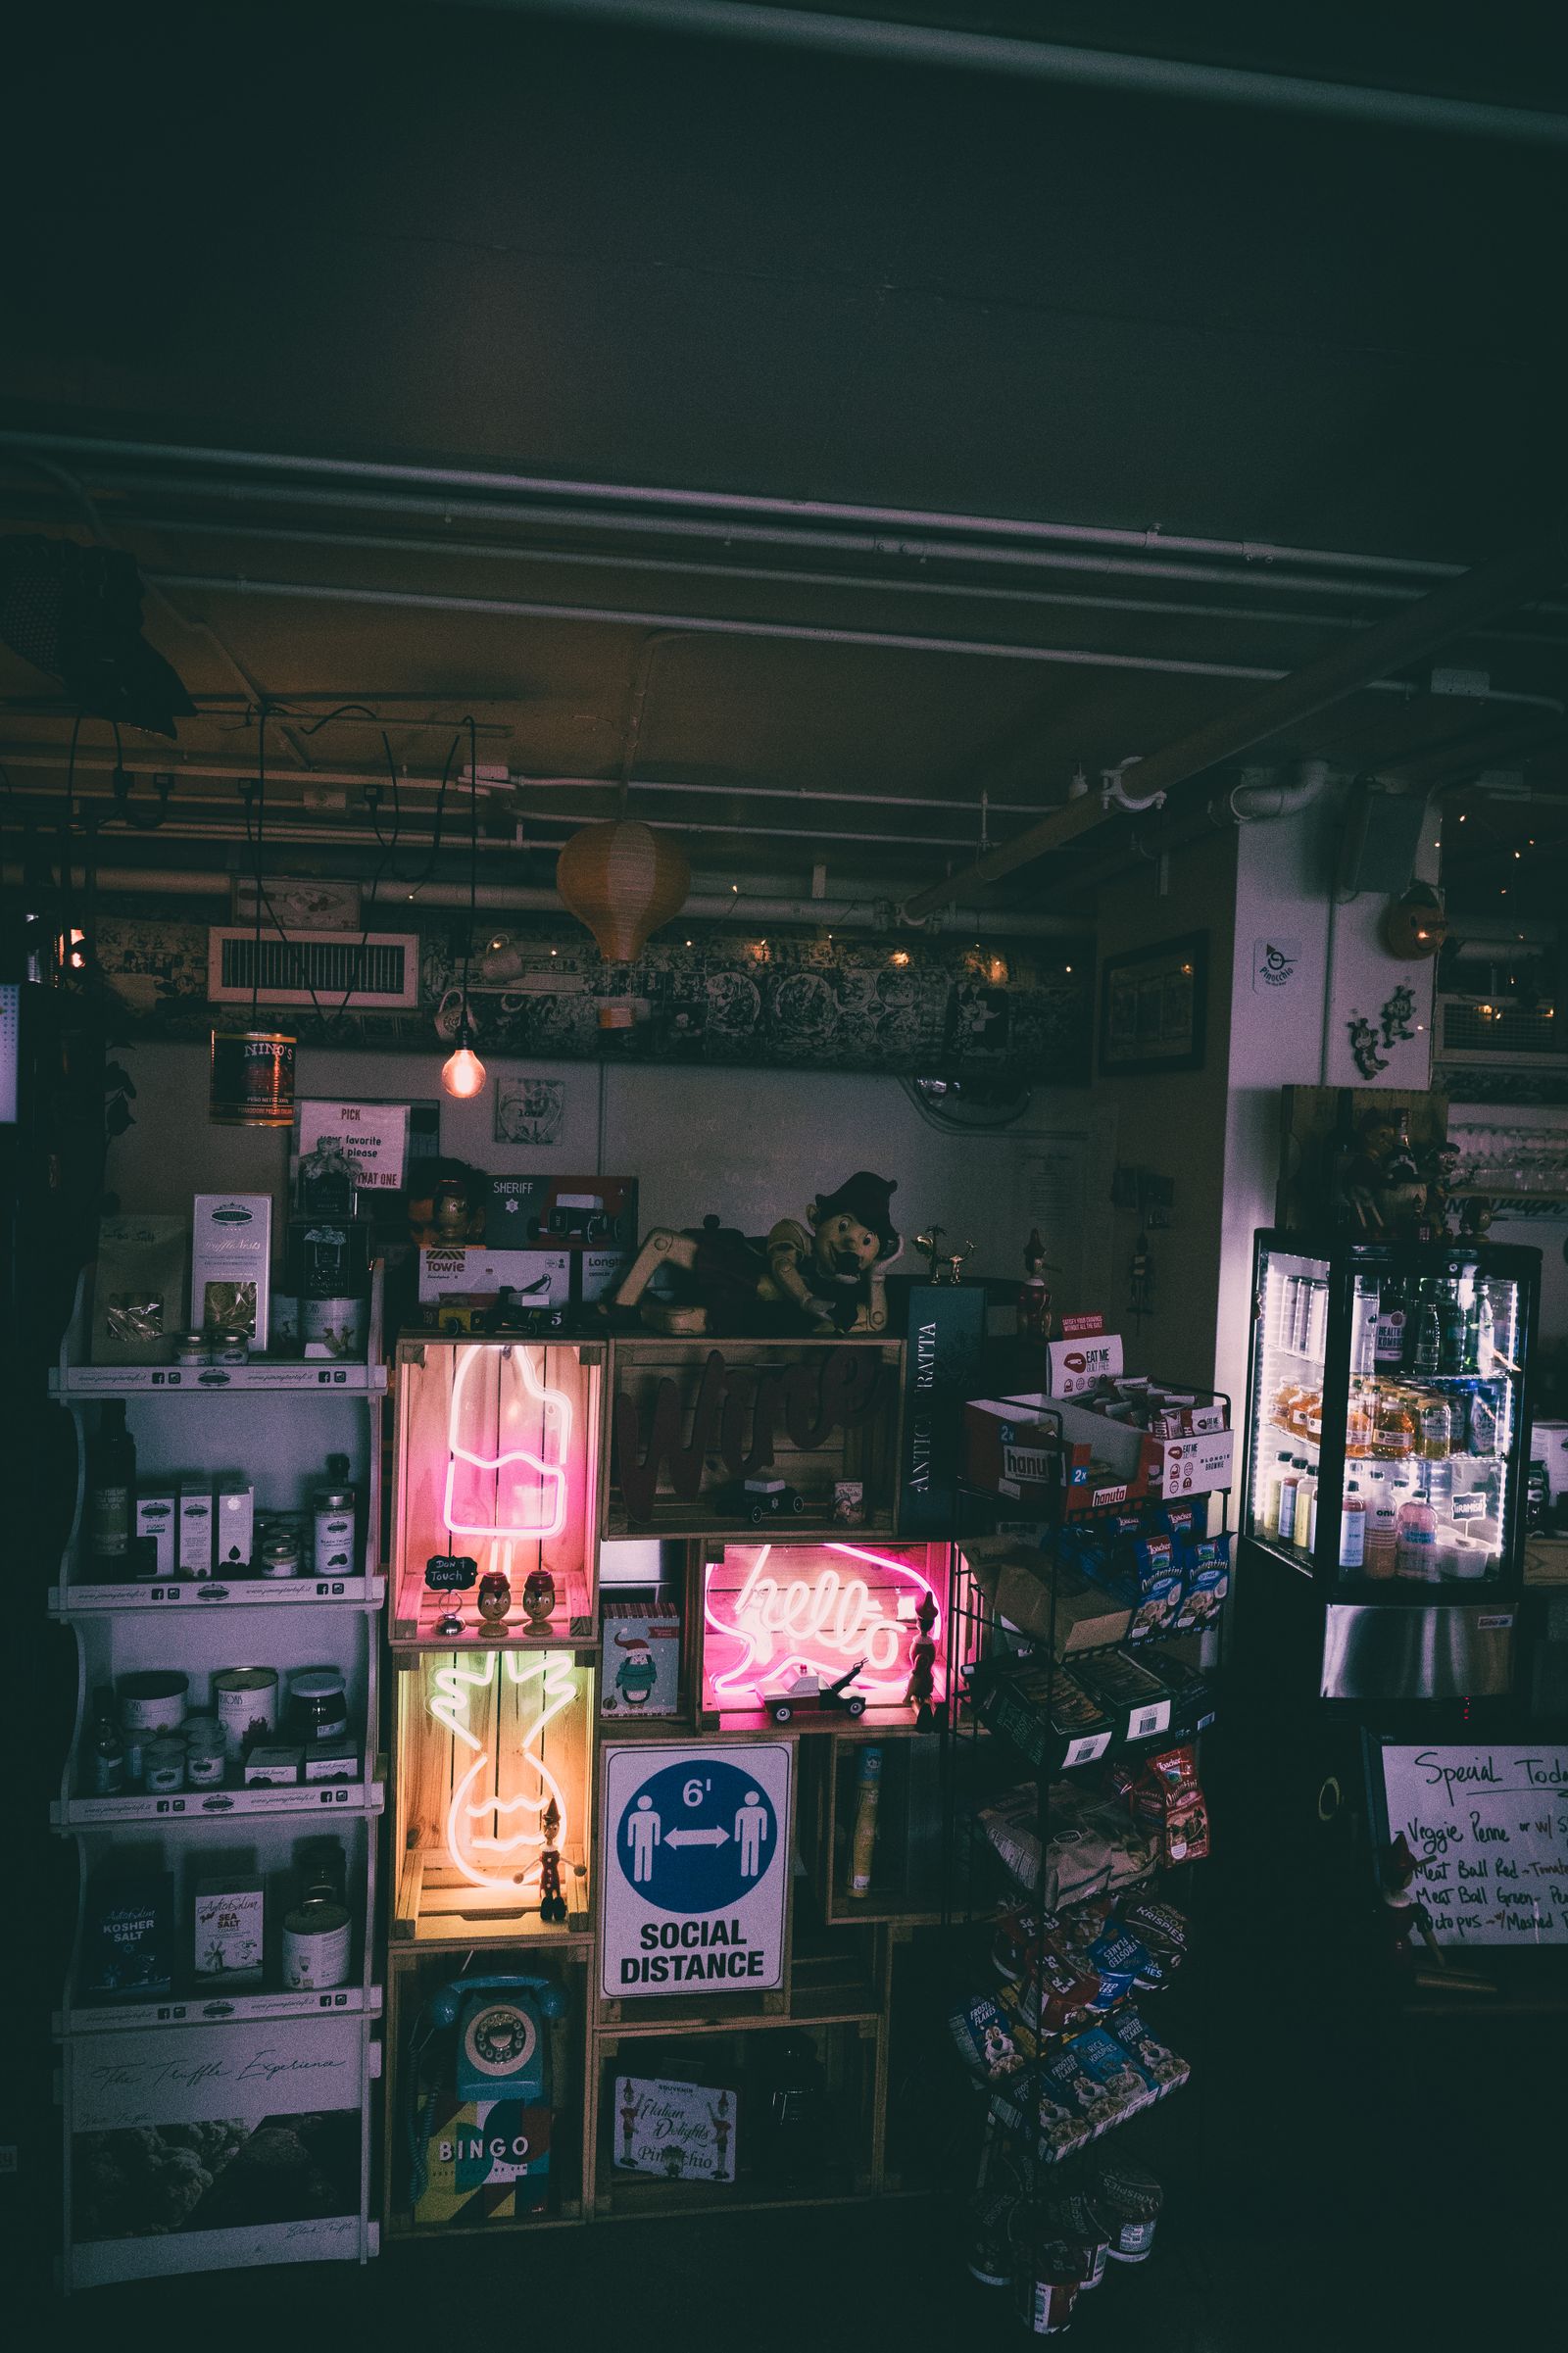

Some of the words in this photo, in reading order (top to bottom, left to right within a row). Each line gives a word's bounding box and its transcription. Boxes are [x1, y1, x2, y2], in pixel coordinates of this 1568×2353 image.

[1259, 966, 1294, 982] Pinocchio
[244, 1043, 293, 1060] NINO'S
[341, 1108, 361, 1120] PICK
[346, 1135, 381, 1146] favorite
[348, 1149, 377, 1159] please
[380, 1173, 397, 1186] ONE
[493, 1182, 533, 1195] SHERIFF
[425, 1260, 466, 1272] Towie
[1086, 1349, 1099, 1363] EAT
[1099, 1348, 1109, 1361] ME
[1001, 1425, 1014, 1442] 2x
[1007, 1448, 1056, 1477] hanu
[1074, 1469, 1088, 1483] 2x
[1094, 1488, 1126, 1506] hanuta
[1146, 1543, 1172, 1555] Loacker
[733, 1544, 908, 1668] hello
[1414, 1752, 1503, 1807] Special
[682, 1779, 711, 1807] 6'
[1408, 1818, 1463, 1854] Veggie
[1470, 1811, 1510, 1842] Penne
[1414, 1862, 1450, 1881] Meat
[1458, 1858, 1488, 1879] Ball
[1495, 1858, 1518, 1879] Red
[1416, 1887, 1454, 1905] Meat
[1458, 1887, 1488, 1904] Ball
[218, 1920, 240, 1929] SALT
[219, 1912, 237, 1921] SEA
[1136, 1906, 1186, 1942] KRISPIES
[1149, 1905, 1183, 1932] COCOA
[103, 1920, 155, 1934] KOSHER
[114, 1931, 144, 1942] SALT
[640, 1919, 747, 1950] SOCIAL
[1102, 1936, 1130, 1960] FLAKES
[1108, 1942, 1138, 1969] FROSTED
[620, 1950, 764, 1984] DISTANCE
[1117, 2018, 1141, 2039] FROSTED
[1123, 2025, 1144, 2042] FLAKES
[1087, 2039, 1104, 2053] RICE
[1089, 2043, 1118, 2064] KRISPIES
[150, 2059, 230, 2087] Truffle
[235, 2049, 346, 2081] Experience
[1051, 2054, 1075, 2076] FROSTED
[1057, 2061, 1078, 2081] FLAKES
[640, 2098, 685, 2120] Italian
[653, 2118, 710, 2147] Delights
[439, 2136, 530, 2162] BINGO
[638, 2146, 712, 2169] Pinchio
[1102, 2177, 1154, 2205] KRISPIES
